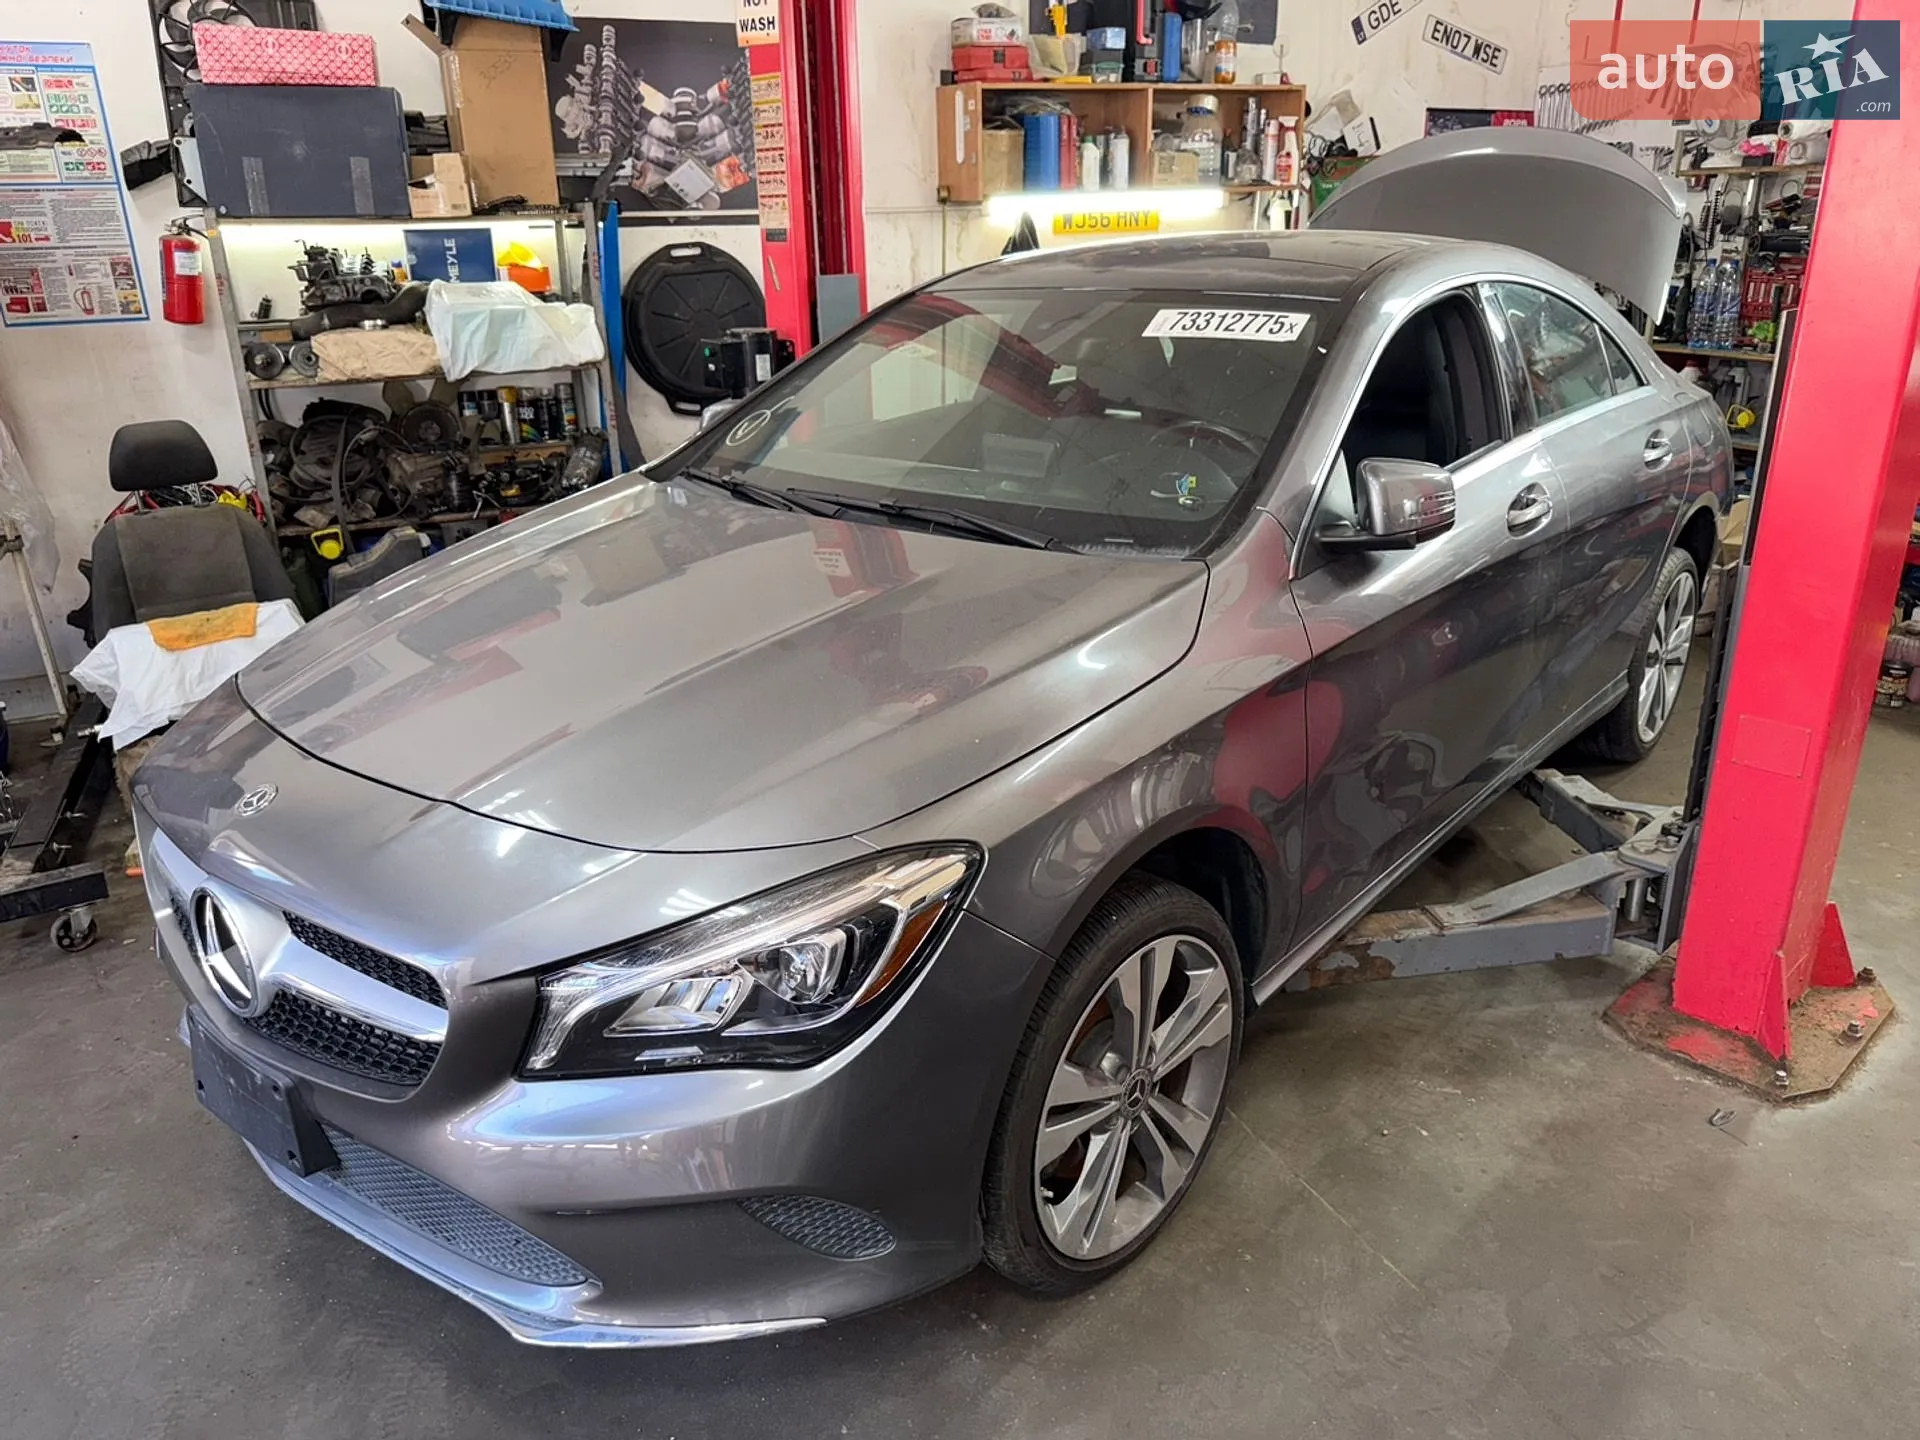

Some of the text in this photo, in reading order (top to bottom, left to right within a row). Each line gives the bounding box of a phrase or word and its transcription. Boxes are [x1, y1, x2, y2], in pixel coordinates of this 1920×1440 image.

[739, 16, 776, 32] WASH
[1431, 20, 1502, 68] EN07 WSE
